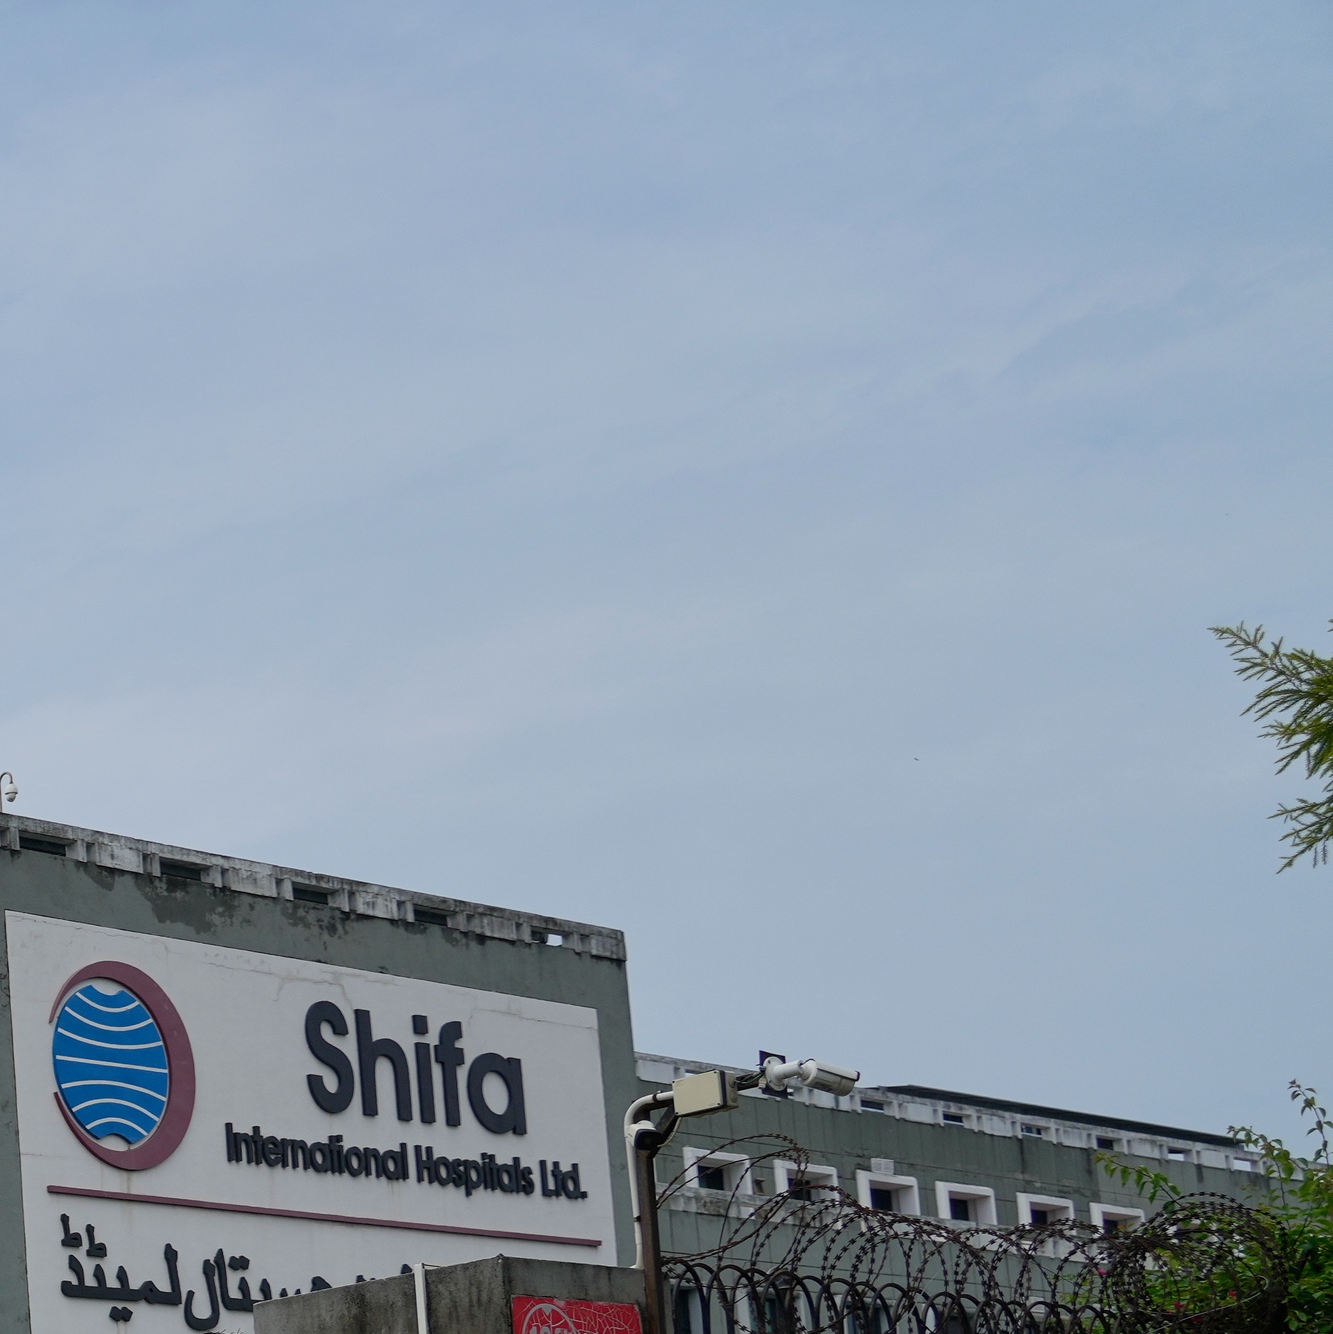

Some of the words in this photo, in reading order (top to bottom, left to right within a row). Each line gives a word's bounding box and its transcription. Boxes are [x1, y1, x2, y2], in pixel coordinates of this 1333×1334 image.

[305, 1001, 528, 1136] Shifa
[224, 1122, 410, 1182] International
[414, 1144, 535, 1197] Hospitals
[538, 1159, 588, 1200] Ltd.
